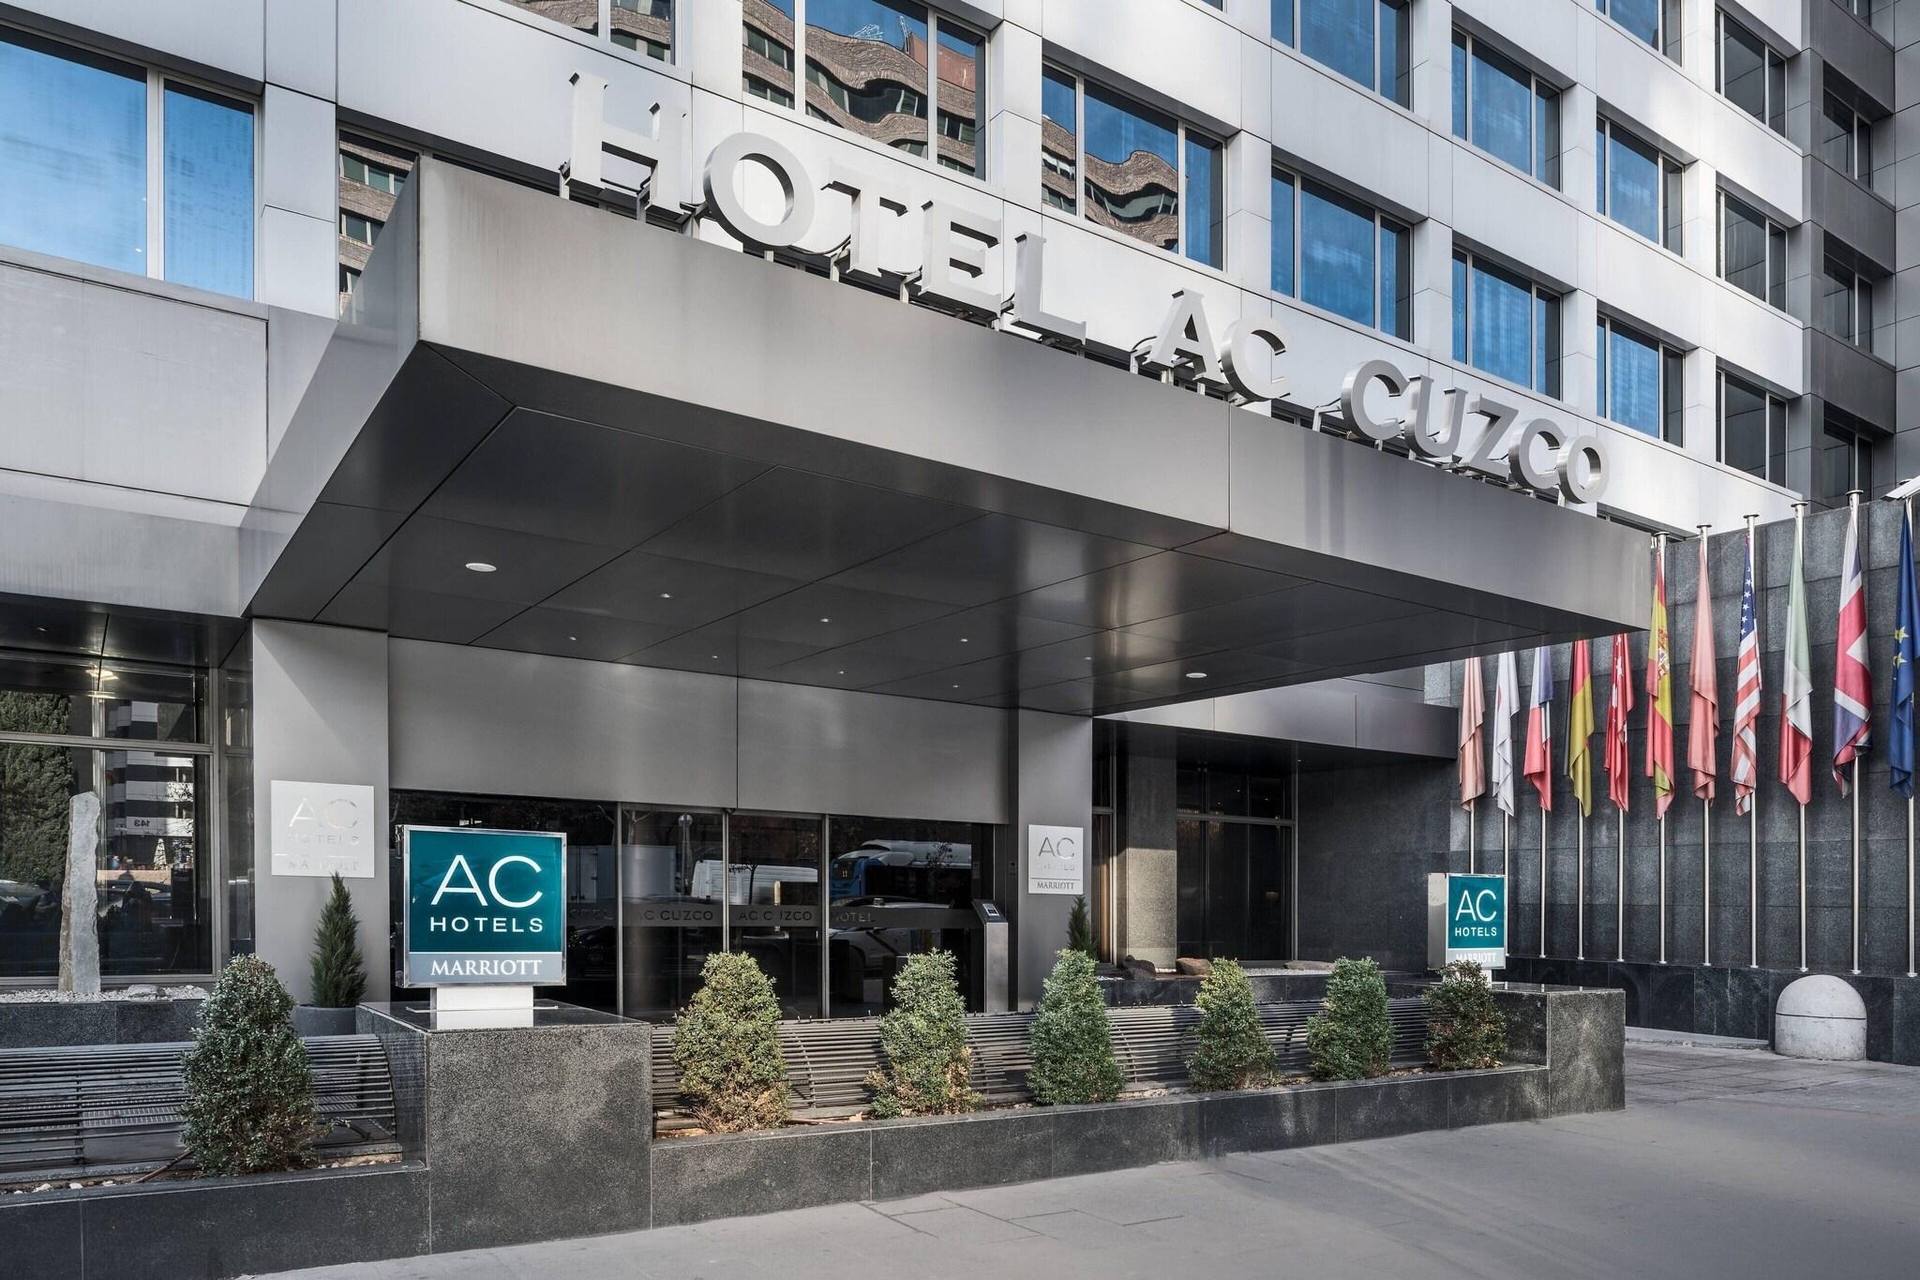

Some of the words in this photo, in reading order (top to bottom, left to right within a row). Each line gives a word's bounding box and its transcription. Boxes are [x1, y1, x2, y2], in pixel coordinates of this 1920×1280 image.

[565, 71, 1087, 346] HOTEL
[1142, 288, 1293, 403] AC
[1340, 358, 1611, 505] CUZCO
[1038, 836, 1076, 860] AC
[430, 854, 544, 909] AC
[1036, 881, 1075, 890] MARRIOTT
[1455, 889, 1497, 922] AC
[659, 910, 714, 921] CUZCO
[738, 910, 758, 921] AC
[430, 916, 543, 933] HOTELS
[1454, 926, 1497, 937] HOTELS
[430, 959, 543, 976] MARRIOTT
